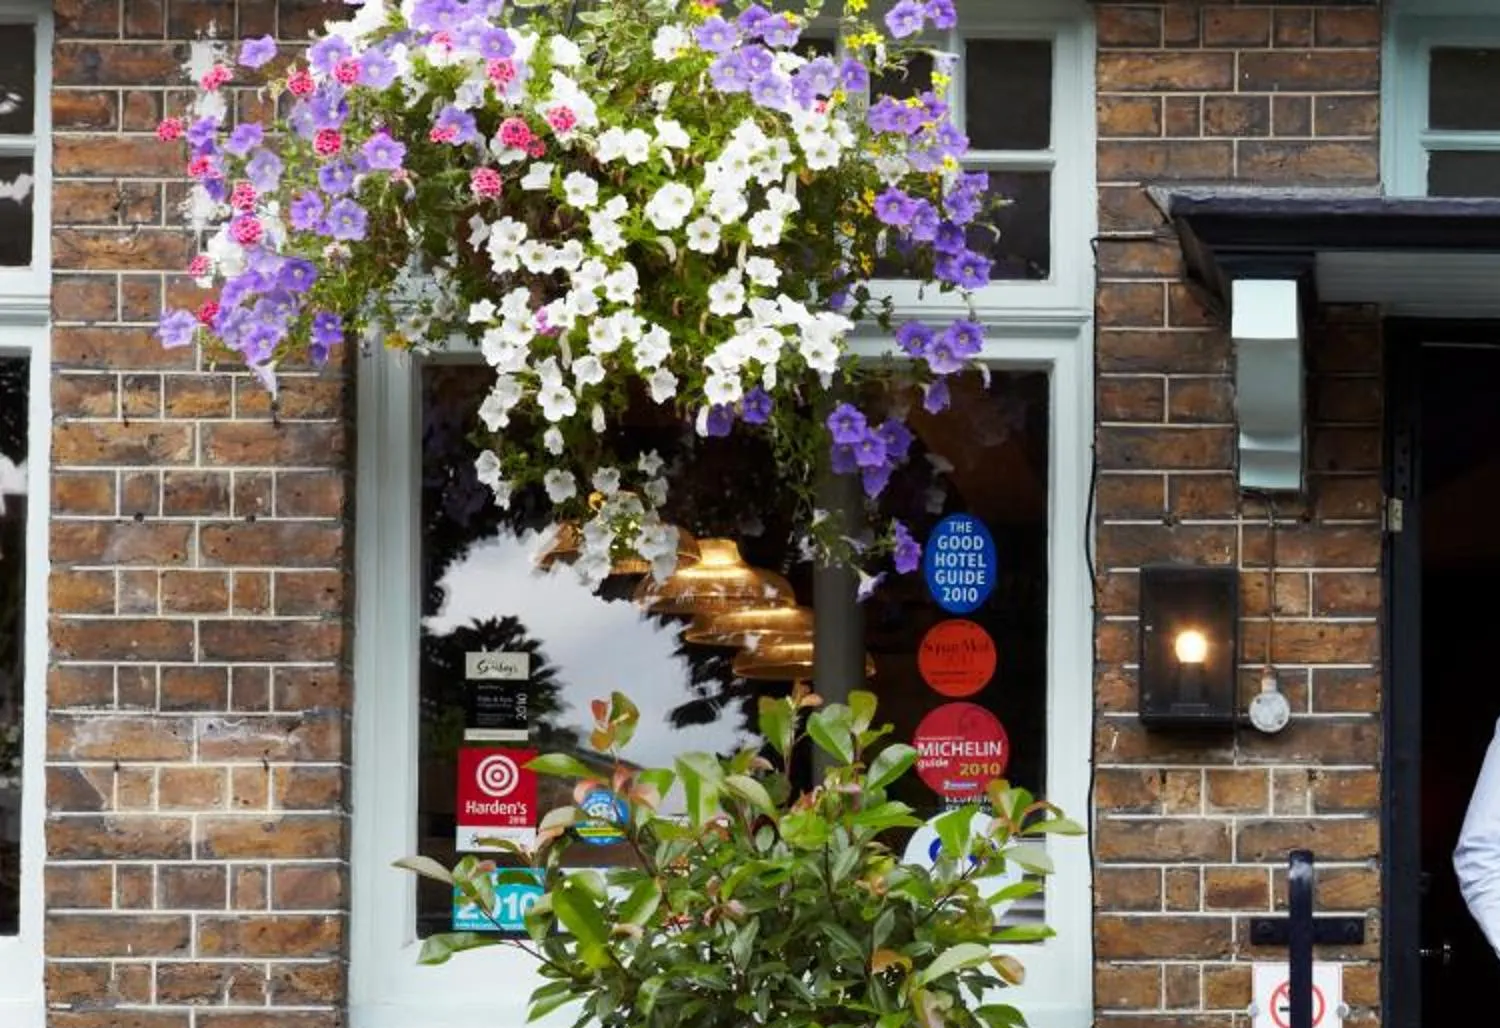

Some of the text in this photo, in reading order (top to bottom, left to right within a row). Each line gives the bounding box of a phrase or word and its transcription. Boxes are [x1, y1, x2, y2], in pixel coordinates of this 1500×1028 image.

[949, 521, 973, 533] THE
[937, 535, 984, 550] GOOD
[935, 552, 987, 568] HOTEL
[934, 569, 986, 585] GUIDE
[942, 587, 979, 602] 2010
[917, 741, 1001, 757] MICHELIN
[917, 757, 948, 769] guide
[960, 763, 1000, 777] 2010
[465, 799, 528, 815] Harden's
